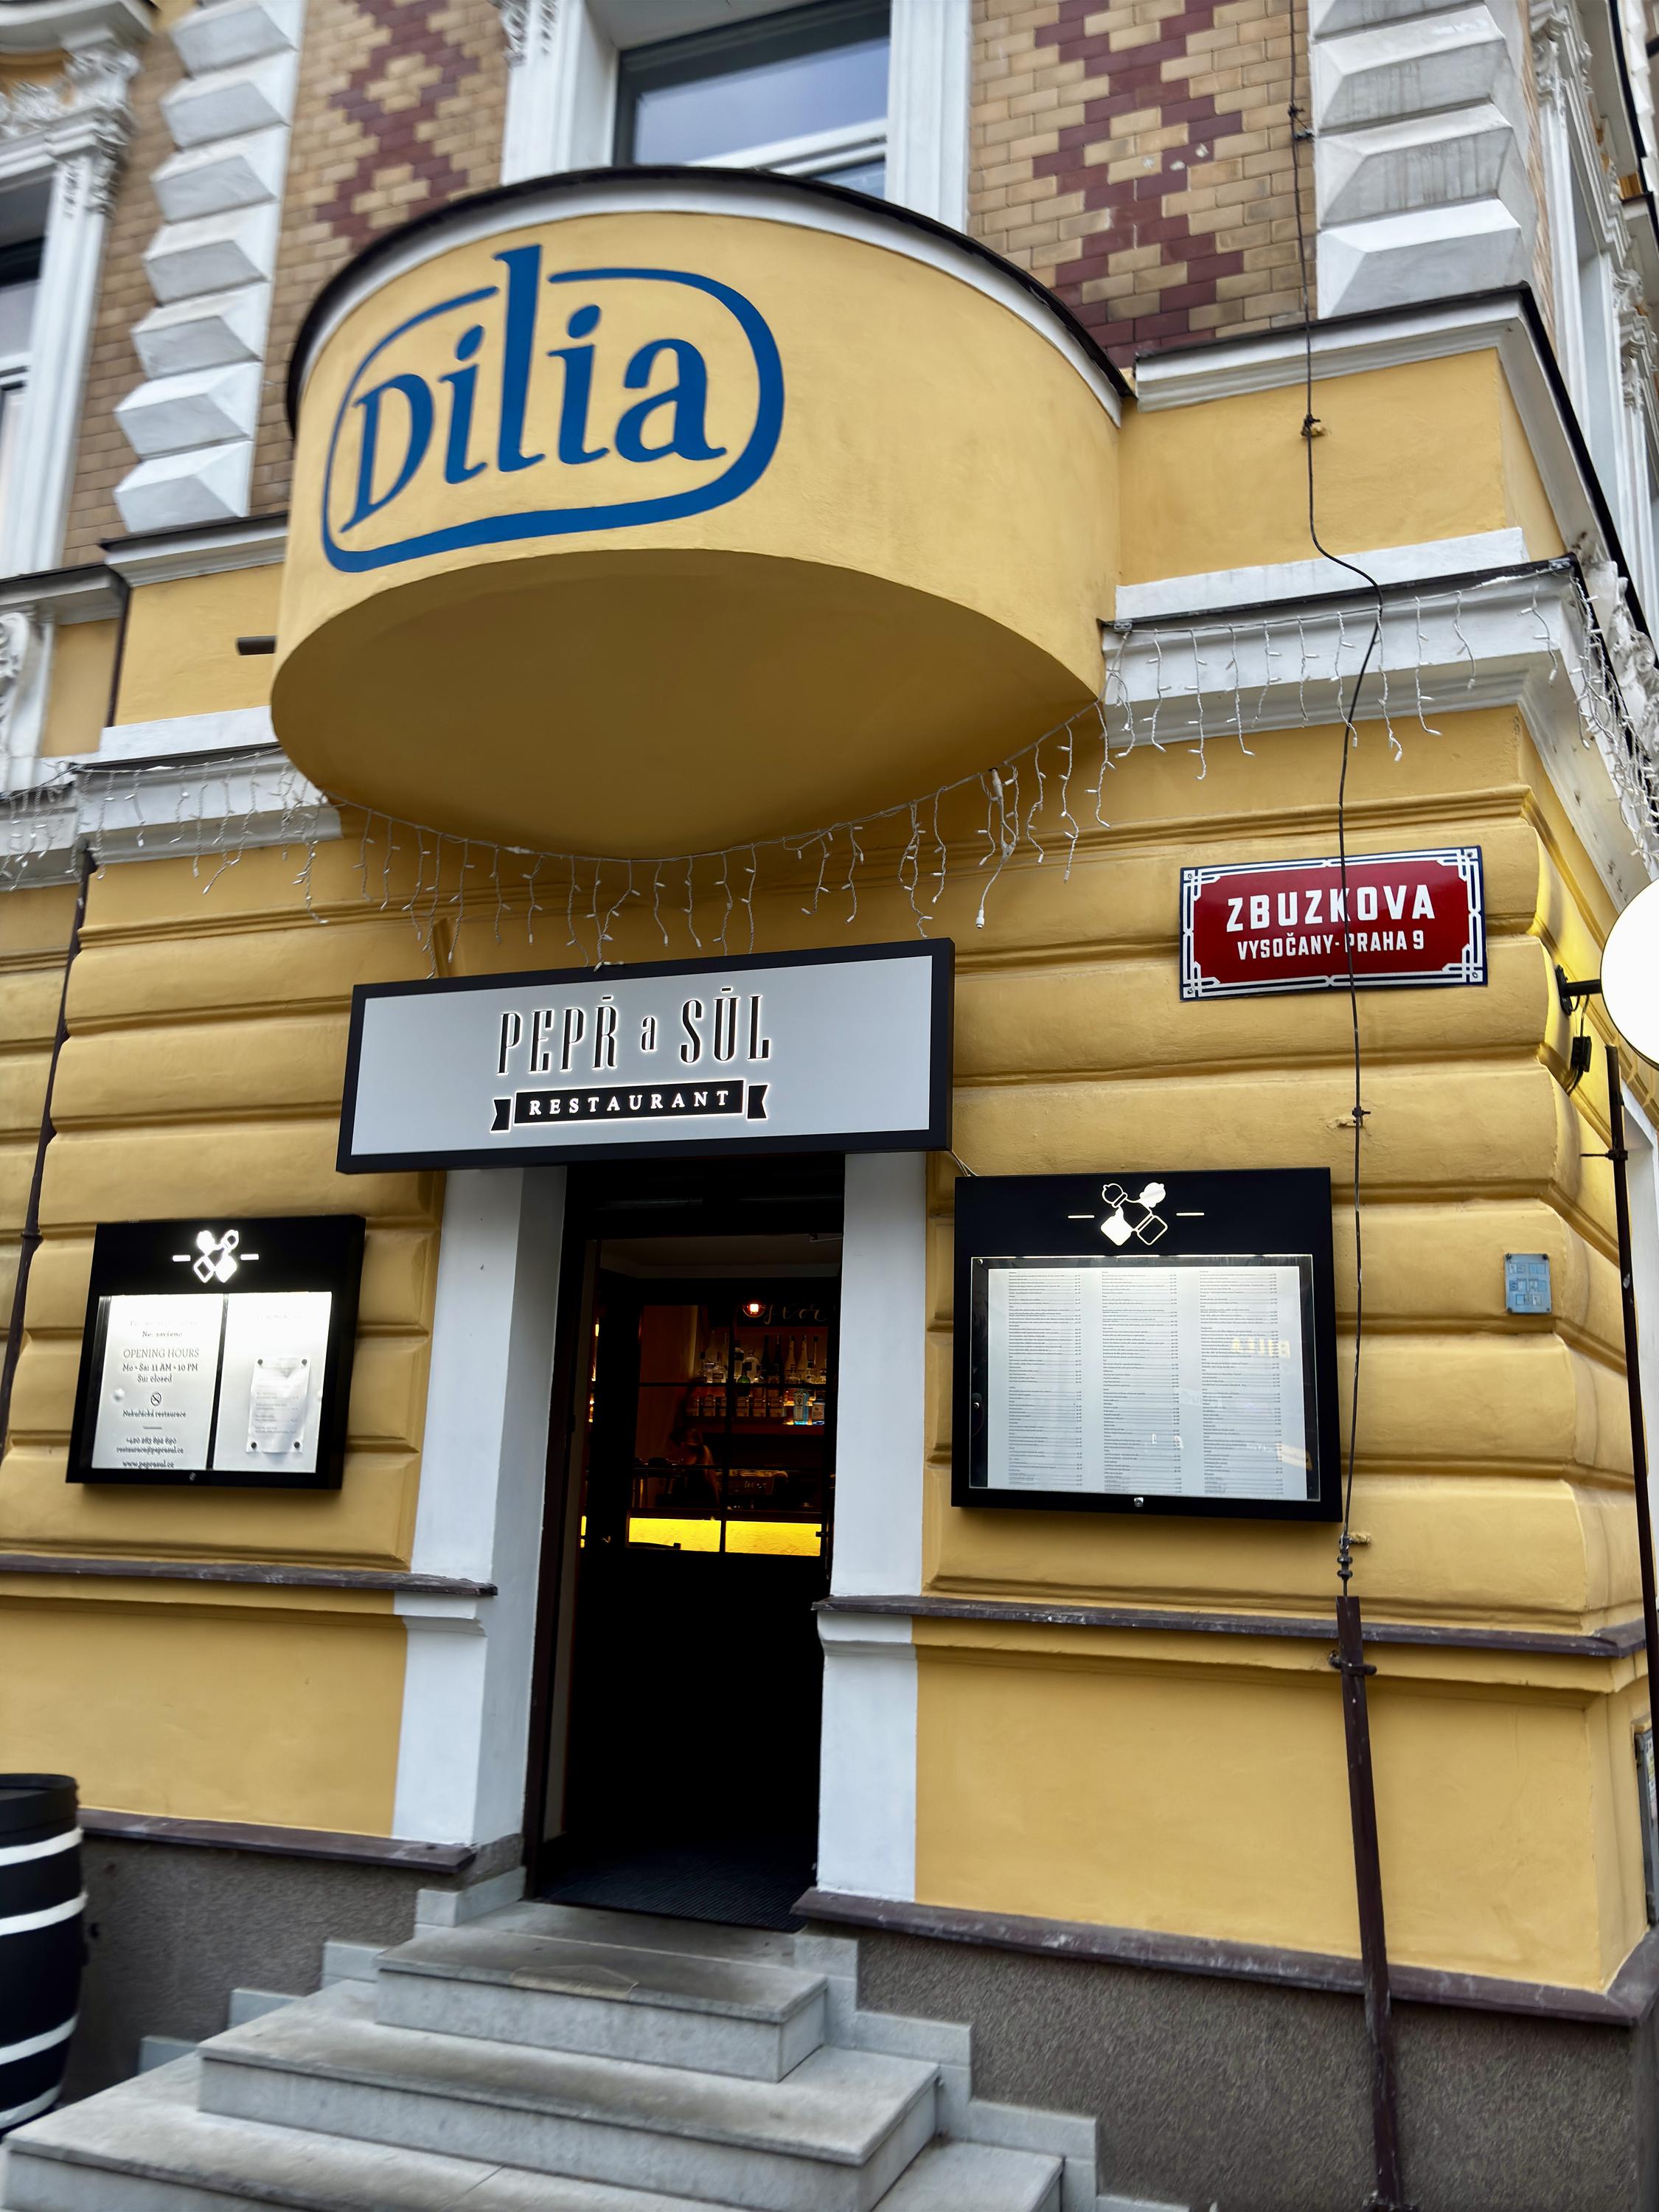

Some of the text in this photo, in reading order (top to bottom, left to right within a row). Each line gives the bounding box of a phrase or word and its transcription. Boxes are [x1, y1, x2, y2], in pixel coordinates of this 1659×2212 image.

[339, 243, 727, 535] Dilia
[1225, 884, 1436, 932] ZBUZKOVA
[1345, 931, 1408, 952] PRAHA
[1412, 930, 1425, 950] 9
[640, 1015, 658, 1052] a
[528, 1091, 729, 1116] RESTAURANT
[123, 1348, 200, 1359] OPENING HOURS
[122, 1363, 133, 1372] Mo
[151, 1363, 159, 1371] 11
[159, 1363, 172, 1371] AM
[178, 1363, 186, 1371] 10
[187, 1363, 199, 1371] PM
[150, 1373, 173, 1382] closed
